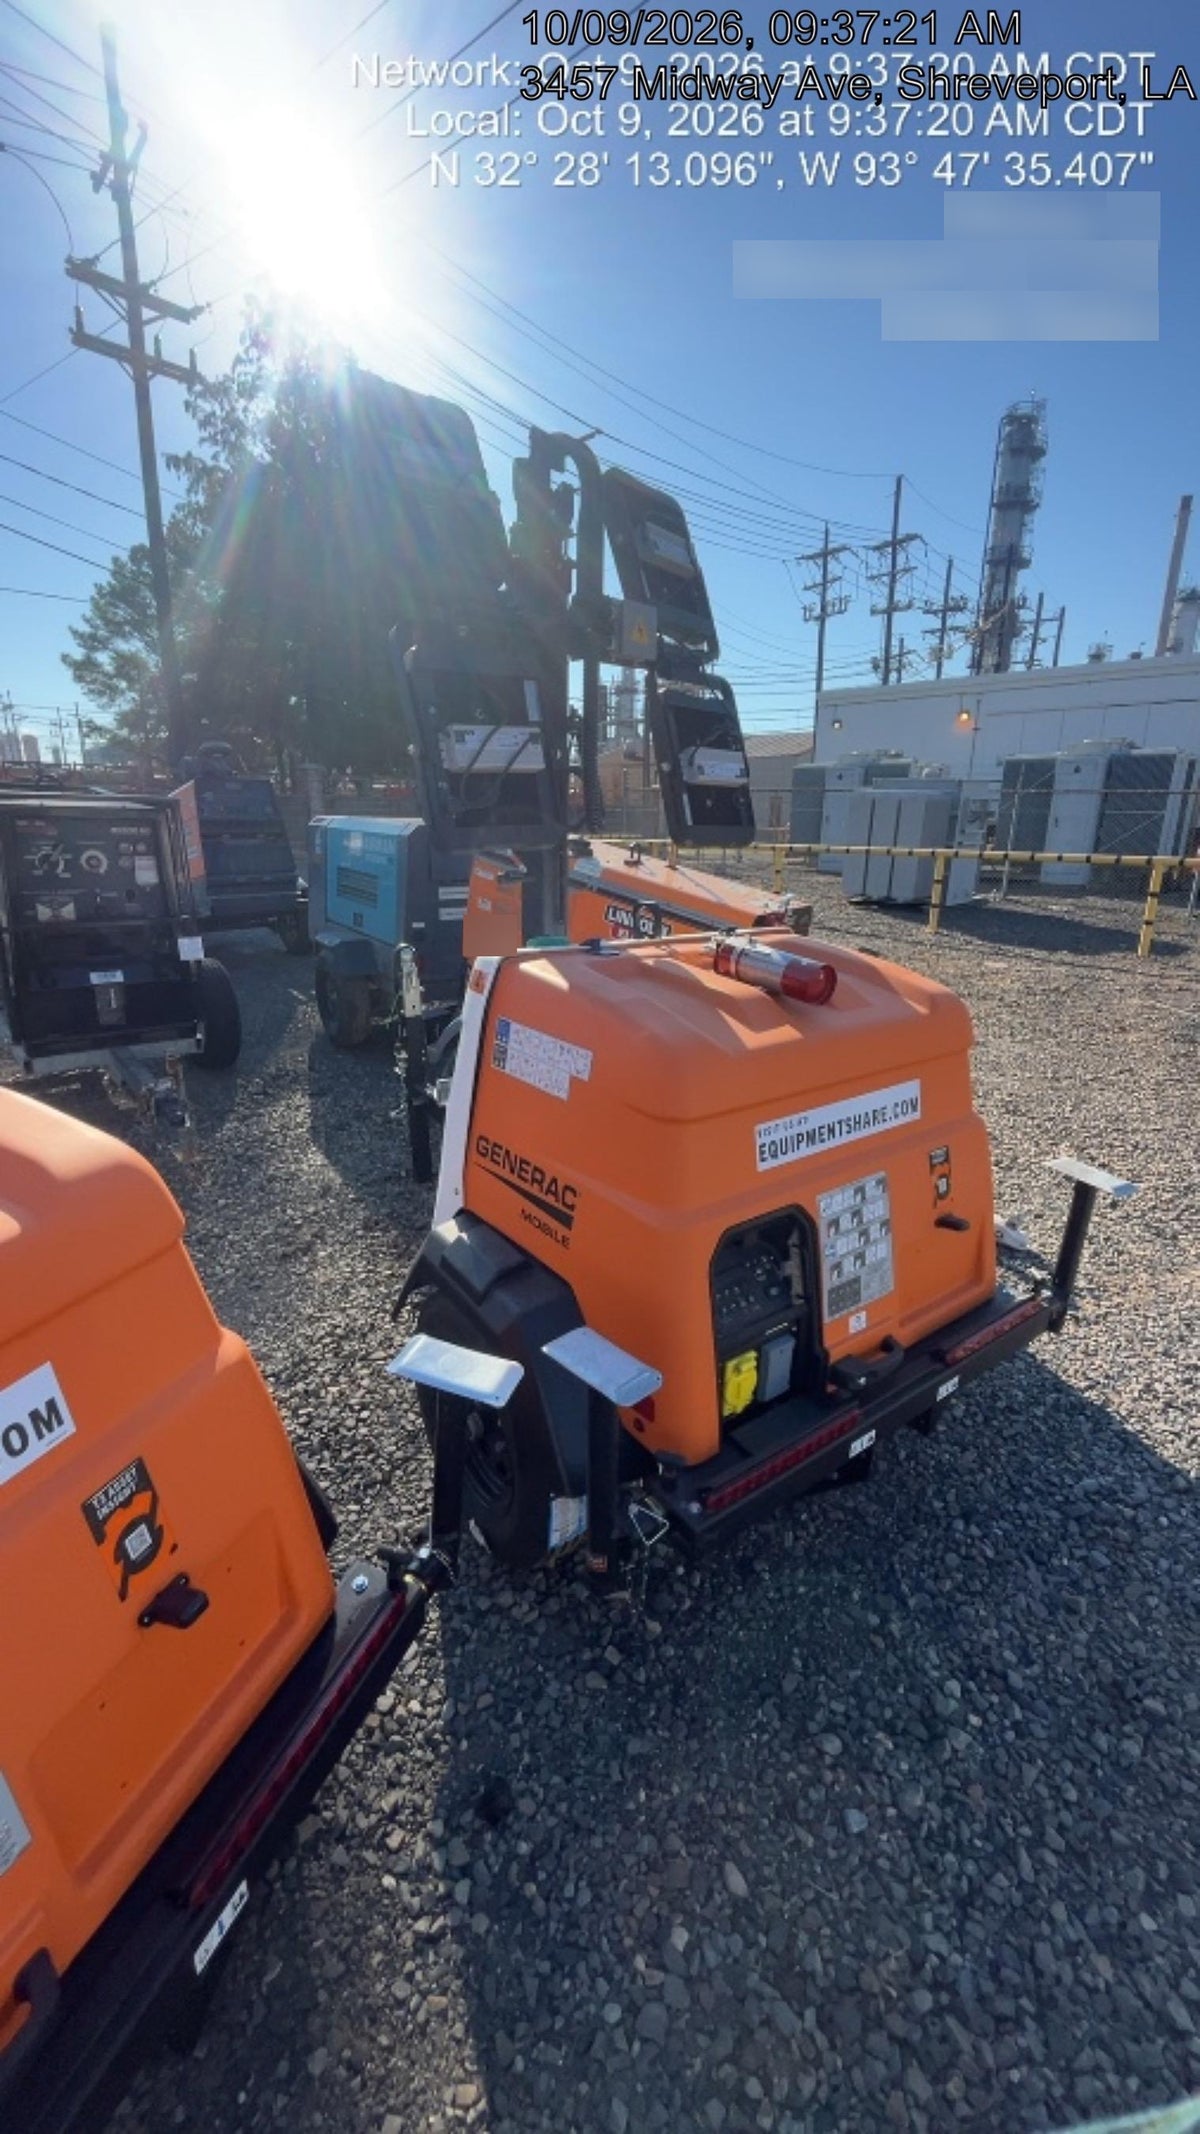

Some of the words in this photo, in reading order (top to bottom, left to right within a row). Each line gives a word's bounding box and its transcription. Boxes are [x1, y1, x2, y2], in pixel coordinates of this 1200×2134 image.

[758, 1096, 919, 1163] EQUIPMENTSHARE.COM
[476, 1134, 577, 1213] GENERAC
[520, 1207, 571, 1250] MOBILE
